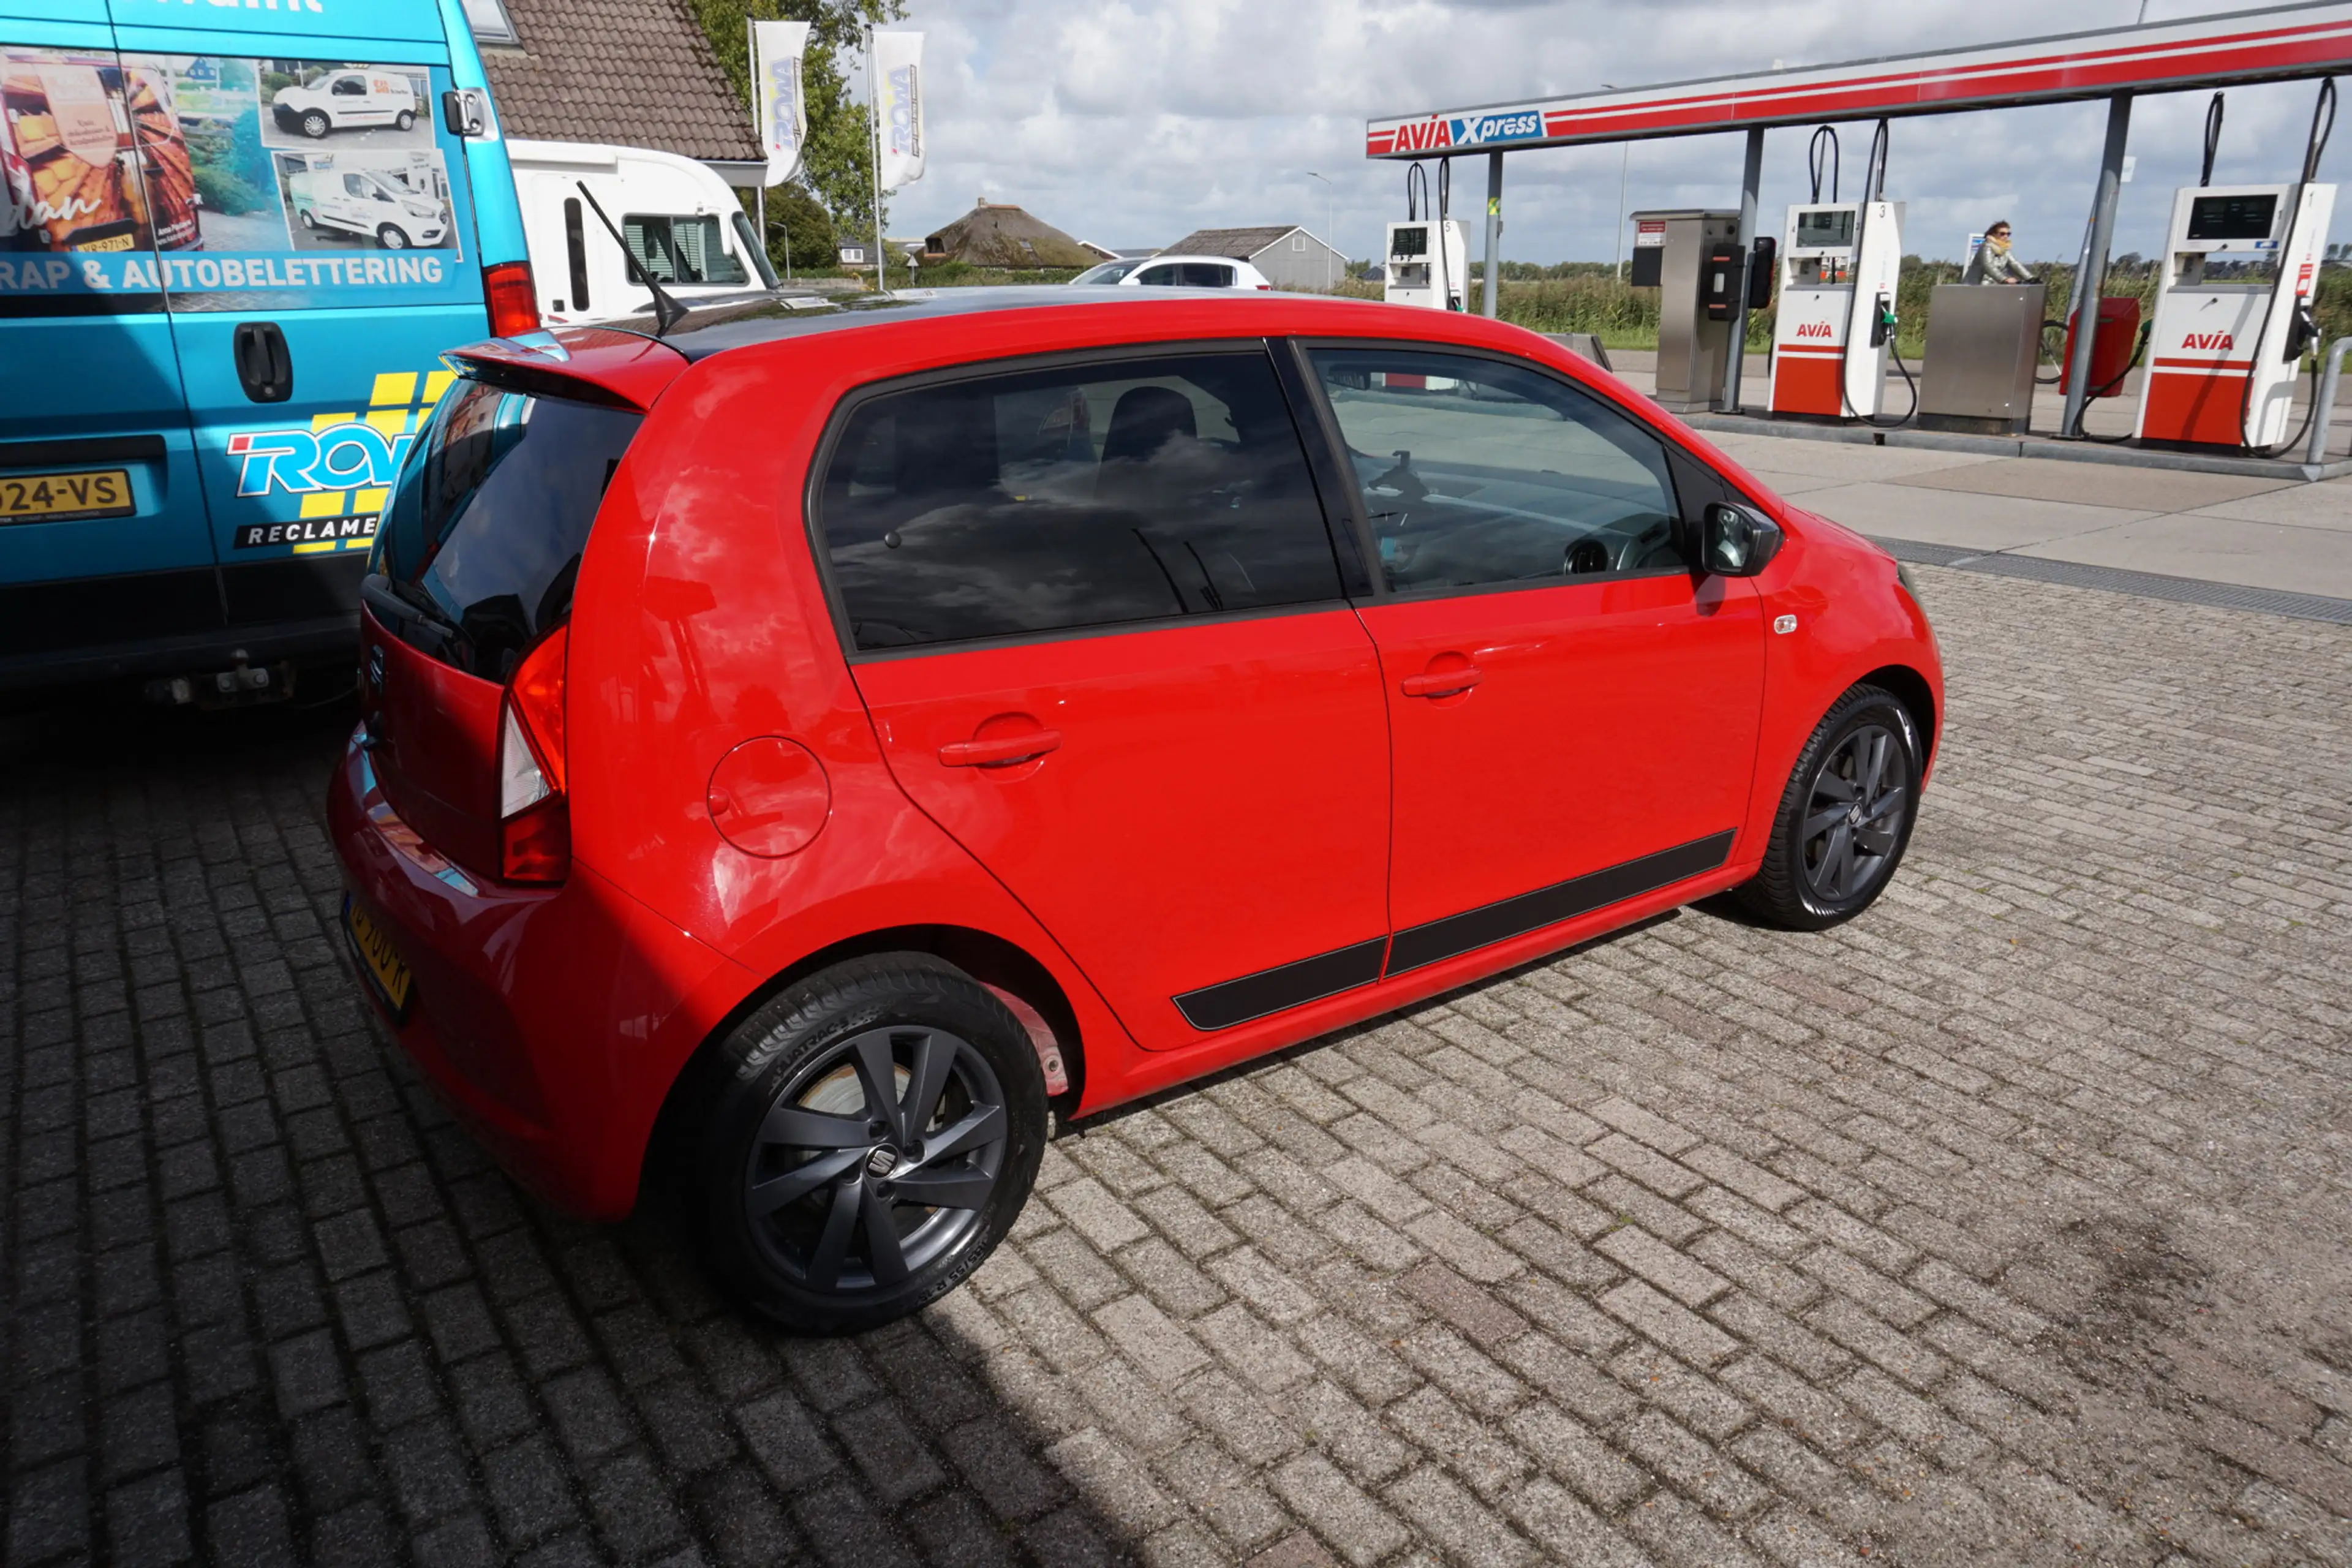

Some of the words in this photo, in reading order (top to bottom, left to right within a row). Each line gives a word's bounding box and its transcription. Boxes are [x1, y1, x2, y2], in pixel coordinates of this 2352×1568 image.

[1395, 114, 1451, 152] AVIA
[1455, 115, 1537, 145] Xpress
[1879, 205, 1886, 218] 3
[1445, 222, 1451, 233] 5
[82, 260, 113, 288] &
[123, 256, 442, 288] AUTOBELETTERING
[1796, 320, 1832, 337] AVIA
[2180, 330, 2233, 351] AVIA
[0, 476, 116, 510] 24-VS
[247, 516, 377, 545] RECLAME
